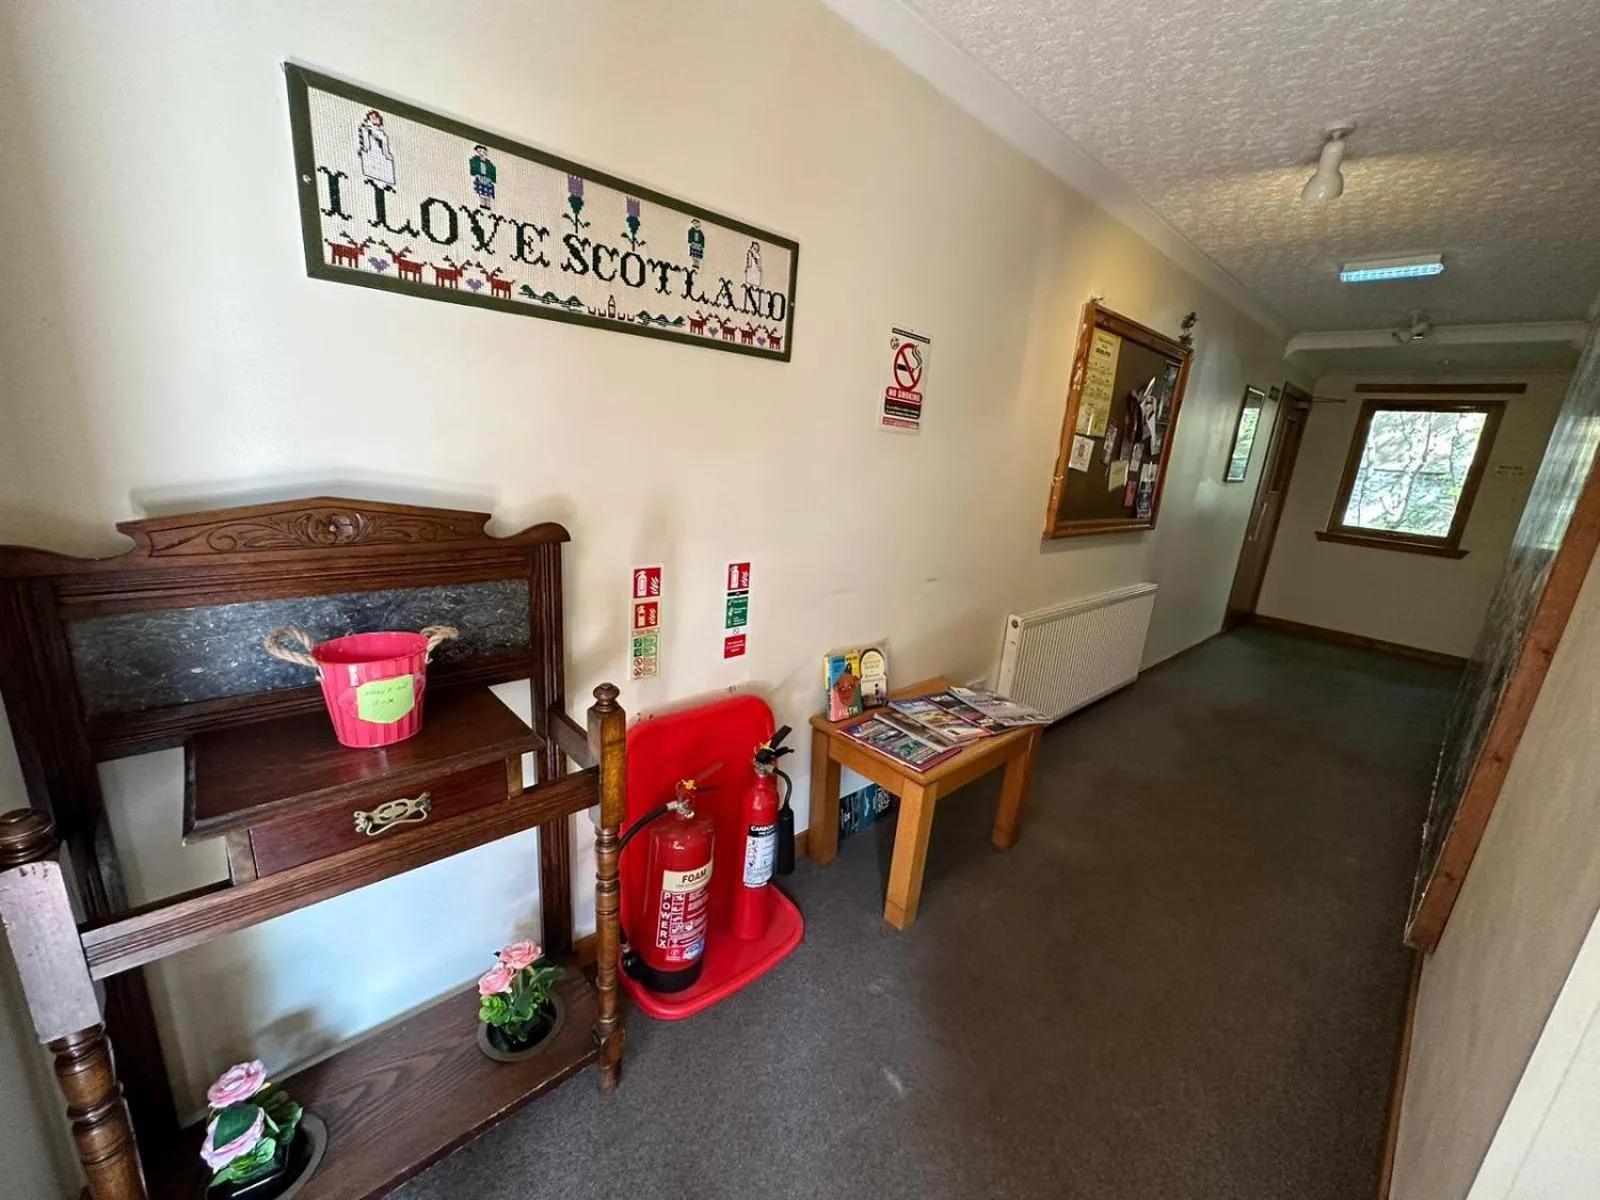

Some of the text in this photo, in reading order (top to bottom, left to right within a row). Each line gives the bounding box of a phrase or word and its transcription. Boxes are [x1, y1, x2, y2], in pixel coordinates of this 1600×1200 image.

[317, 167, 787, 322] I LOVE SCOTLAND
[682, 869, 707, 884] FOAM
